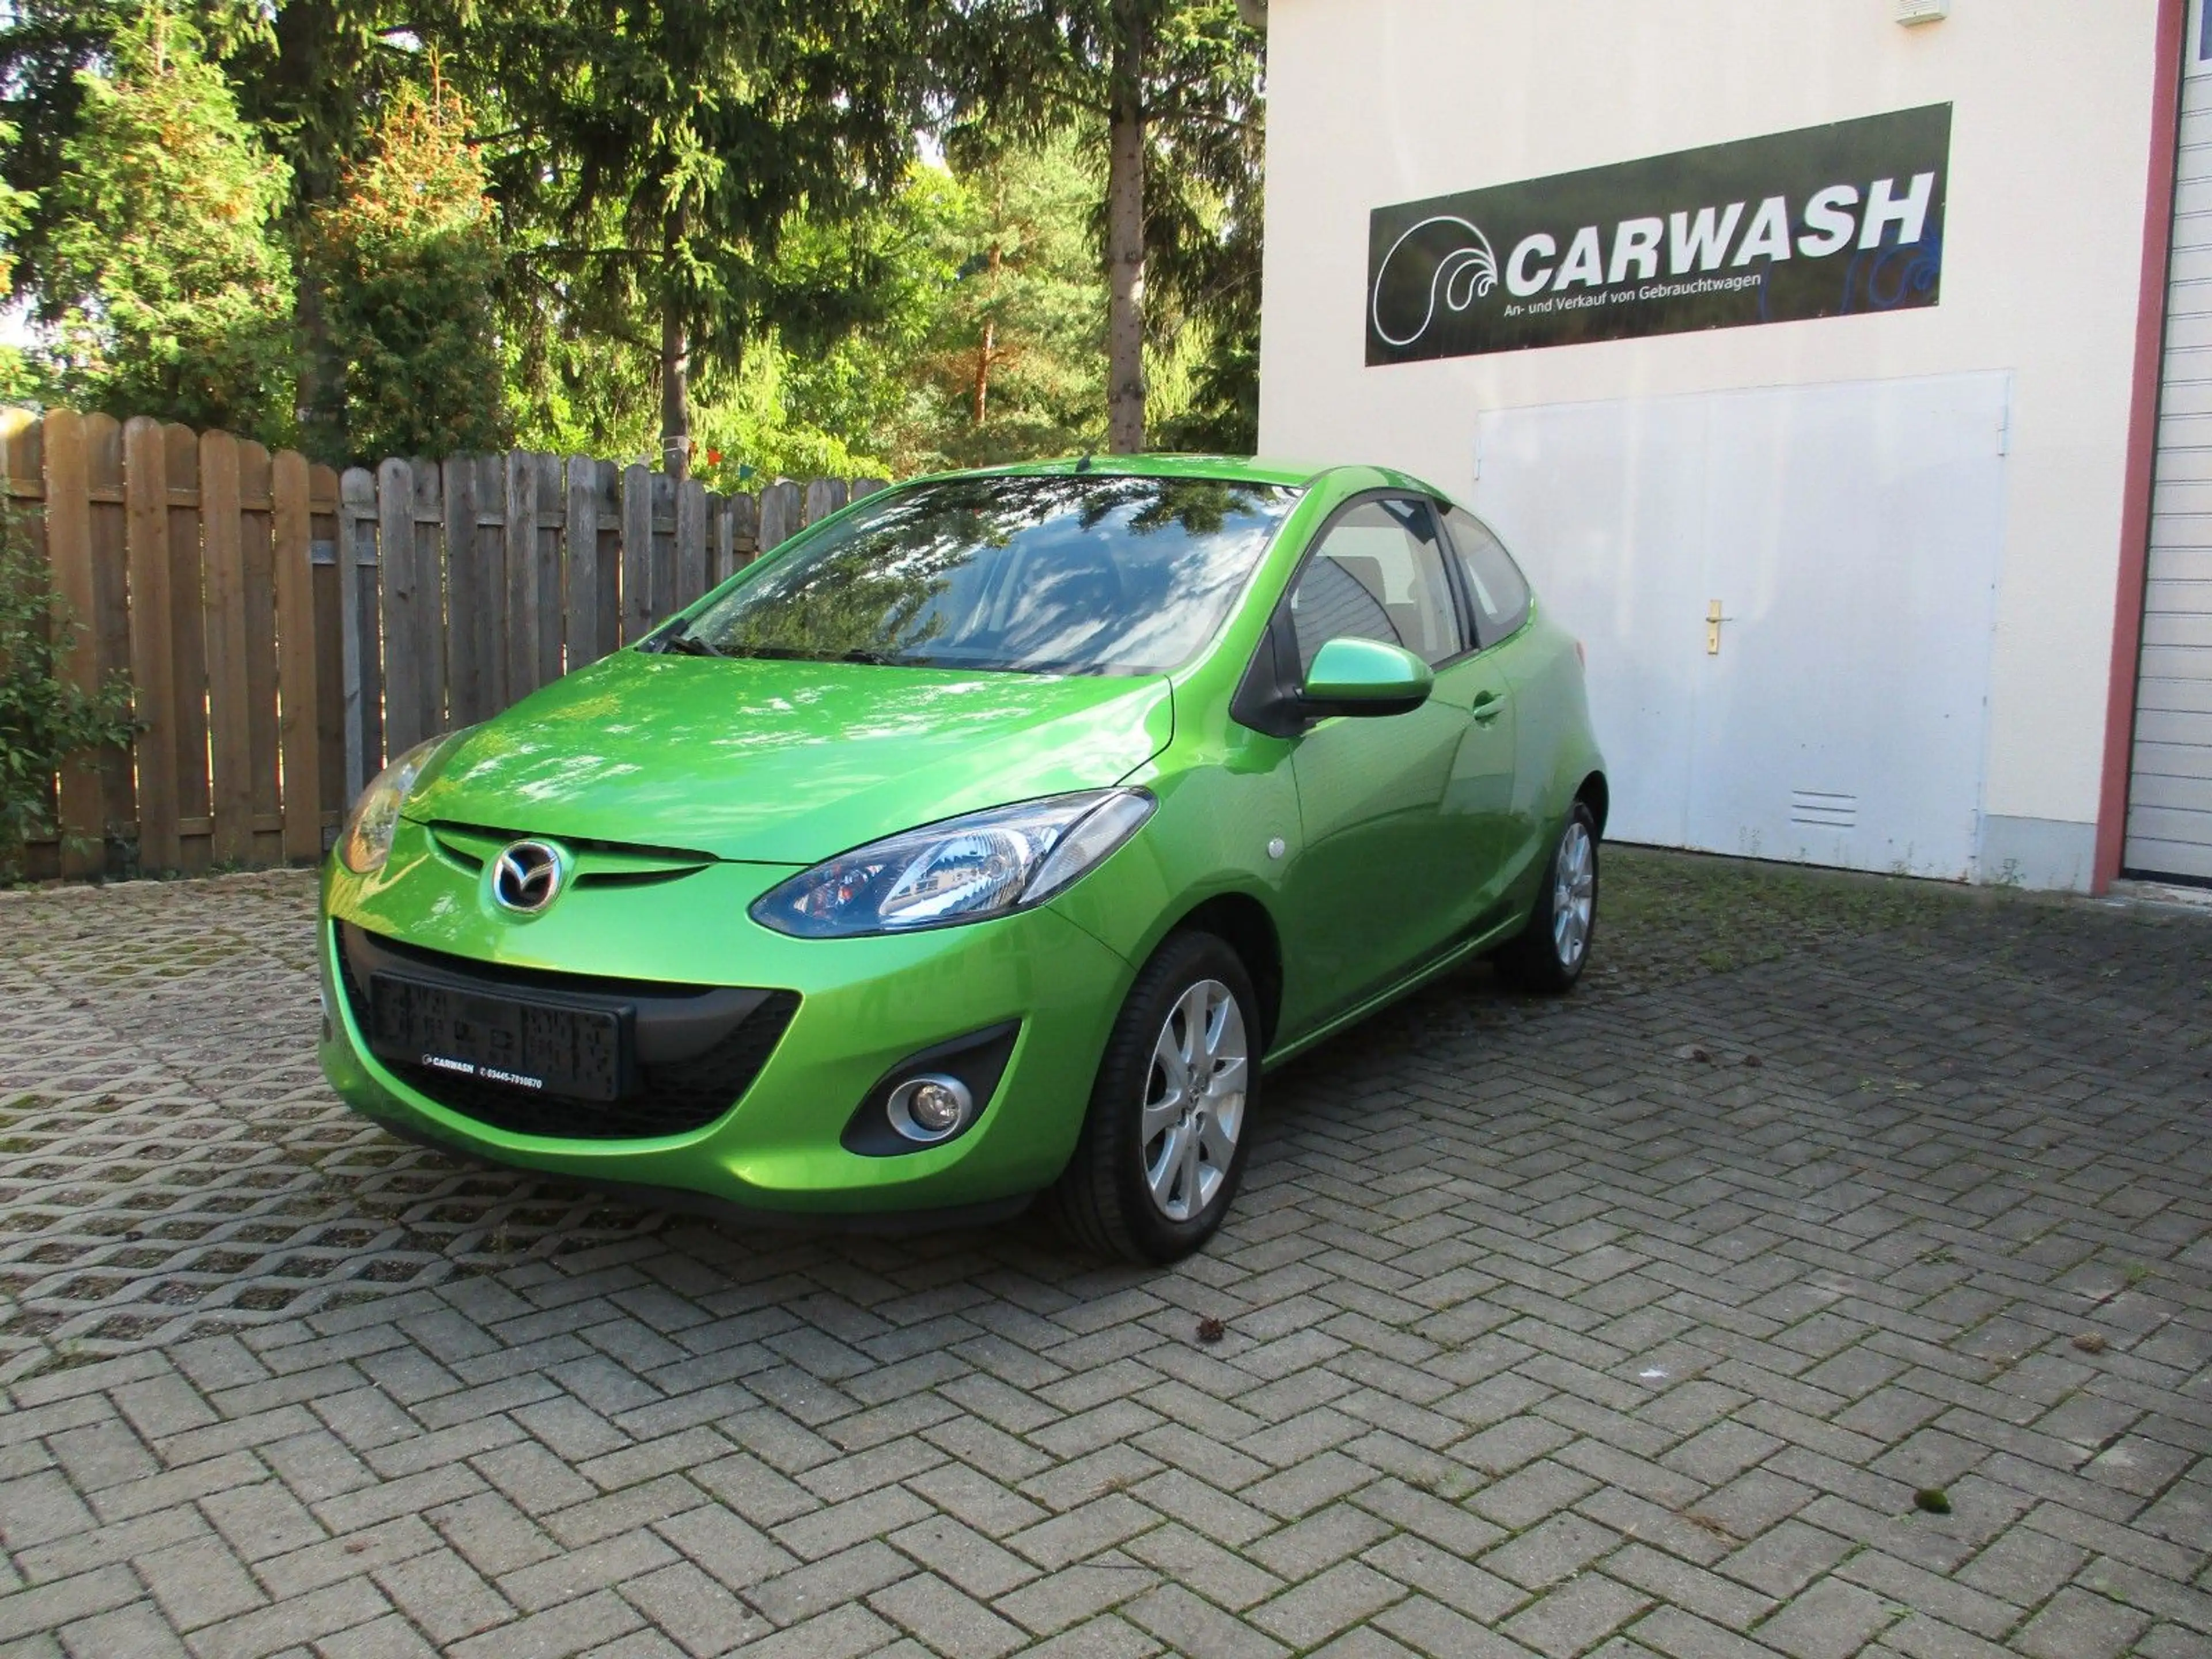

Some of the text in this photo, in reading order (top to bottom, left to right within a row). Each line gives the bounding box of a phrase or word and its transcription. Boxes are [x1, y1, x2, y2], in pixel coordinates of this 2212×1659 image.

[1506, 172, 1935, 297] CARWASH
[1503, 274, 1762, 316] An- und Verkauf von Gebrauchtwagen
[433, 1057, 474, 1074] CARWASH
